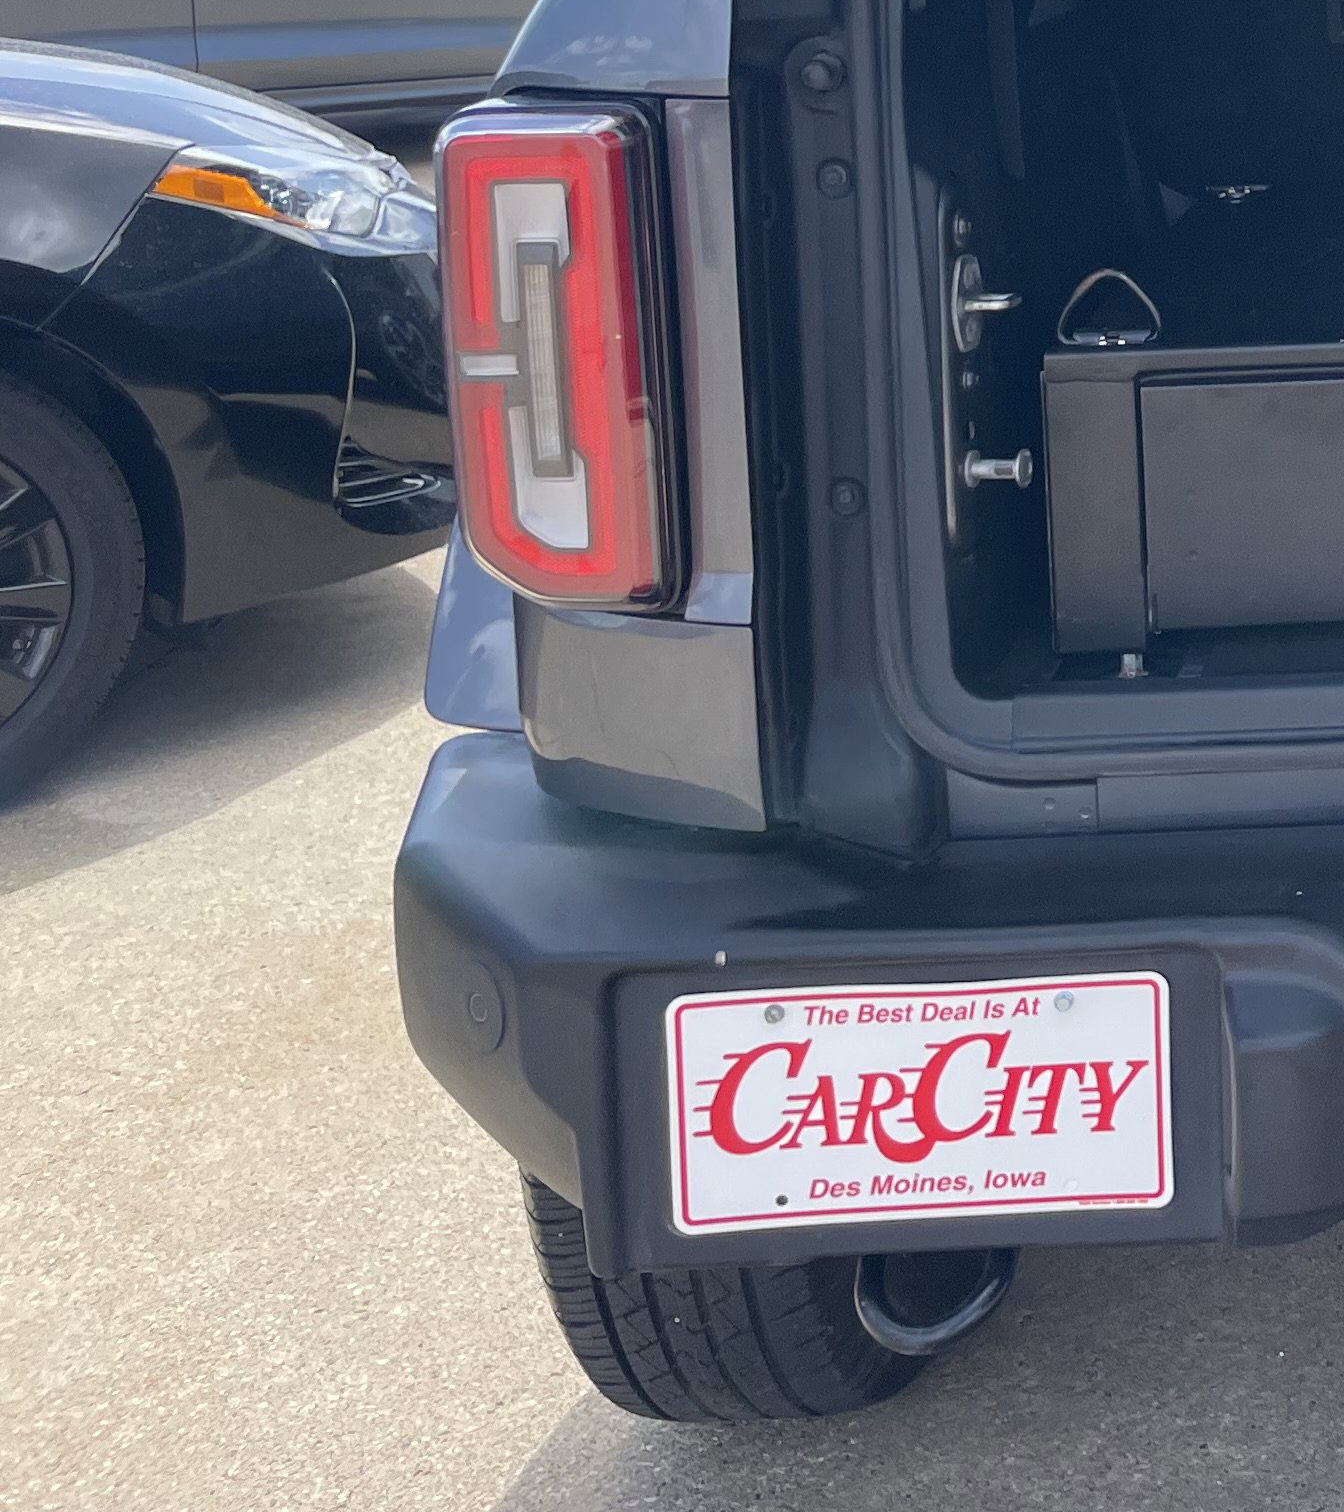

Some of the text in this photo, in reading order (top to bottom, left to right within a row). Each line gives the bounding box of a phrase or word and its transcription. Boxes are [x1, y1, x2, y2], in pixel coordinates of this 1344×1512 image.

[803, 997, 1041, 1026] The Best Deal Is At
[810, 1169, 1047, 1201] Des Moines, Iowa
